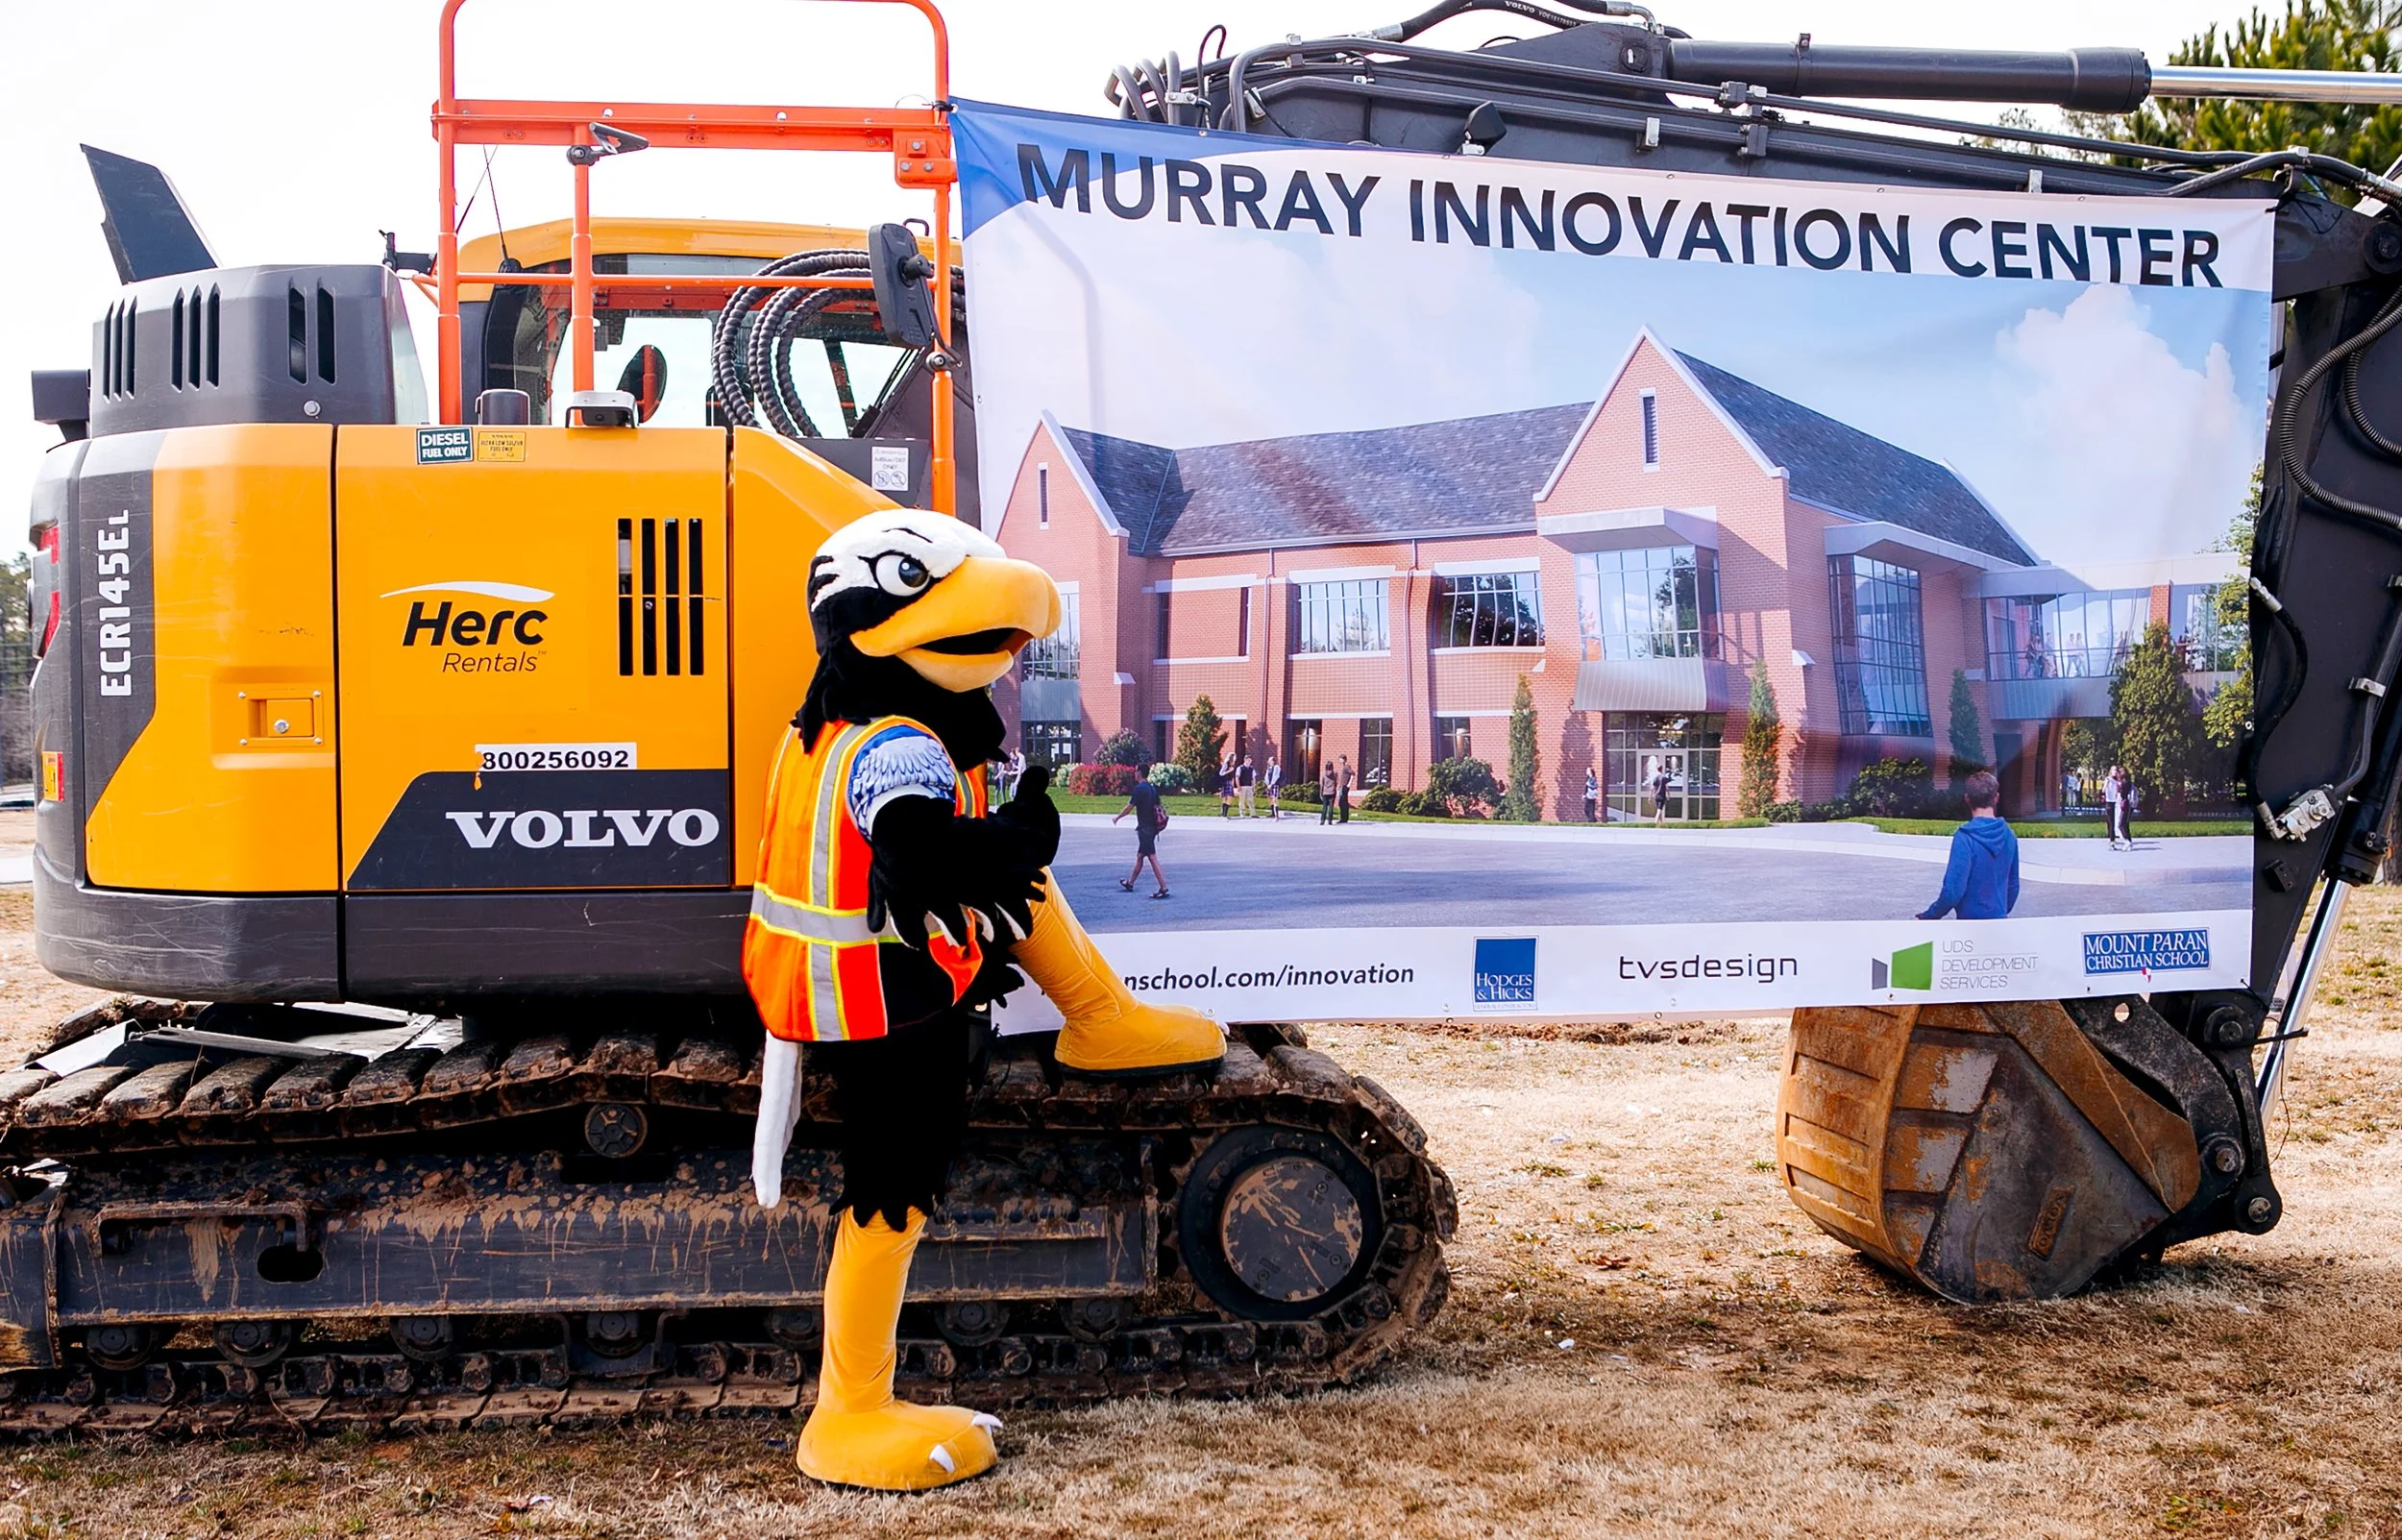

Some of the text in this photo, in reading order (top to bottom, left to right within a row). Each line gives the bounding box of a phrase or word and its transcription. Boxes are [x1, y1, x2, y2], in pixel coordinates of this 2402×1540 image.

[1505, 1, 1535, 13] VOLVO
[1017, 143, 2223, 288] MURRAY INNOVATION CENTER
[421, 432, 469, 447] DIESEL
[423, 447, 467, 458] FUEL ONLY
[98, 509, 132, 697] ECR145EL
[402, 601, 549, 647] Herc
[442, 651, 538, 672] Rentals
[482, 750, 629, 770] 800256092
[445, 808, 720, 848] VOLVO
[1942, 940, 1973, 953] UDS
[2085, 932, 2207, 955] MOUNT PARAN
[1619, 953, 1798, 983] tvsdesign
[1941, 957, 2039, 972] DEVELOPMENT
[2086, 951, 2208, 970] CHRISTIAN SCHOOL
[1476, 972, 1533, 987] HODGES
[1940, 975, 2008, 990] SERVICES
[1476, 987, 1532, 1000] & HICKS
